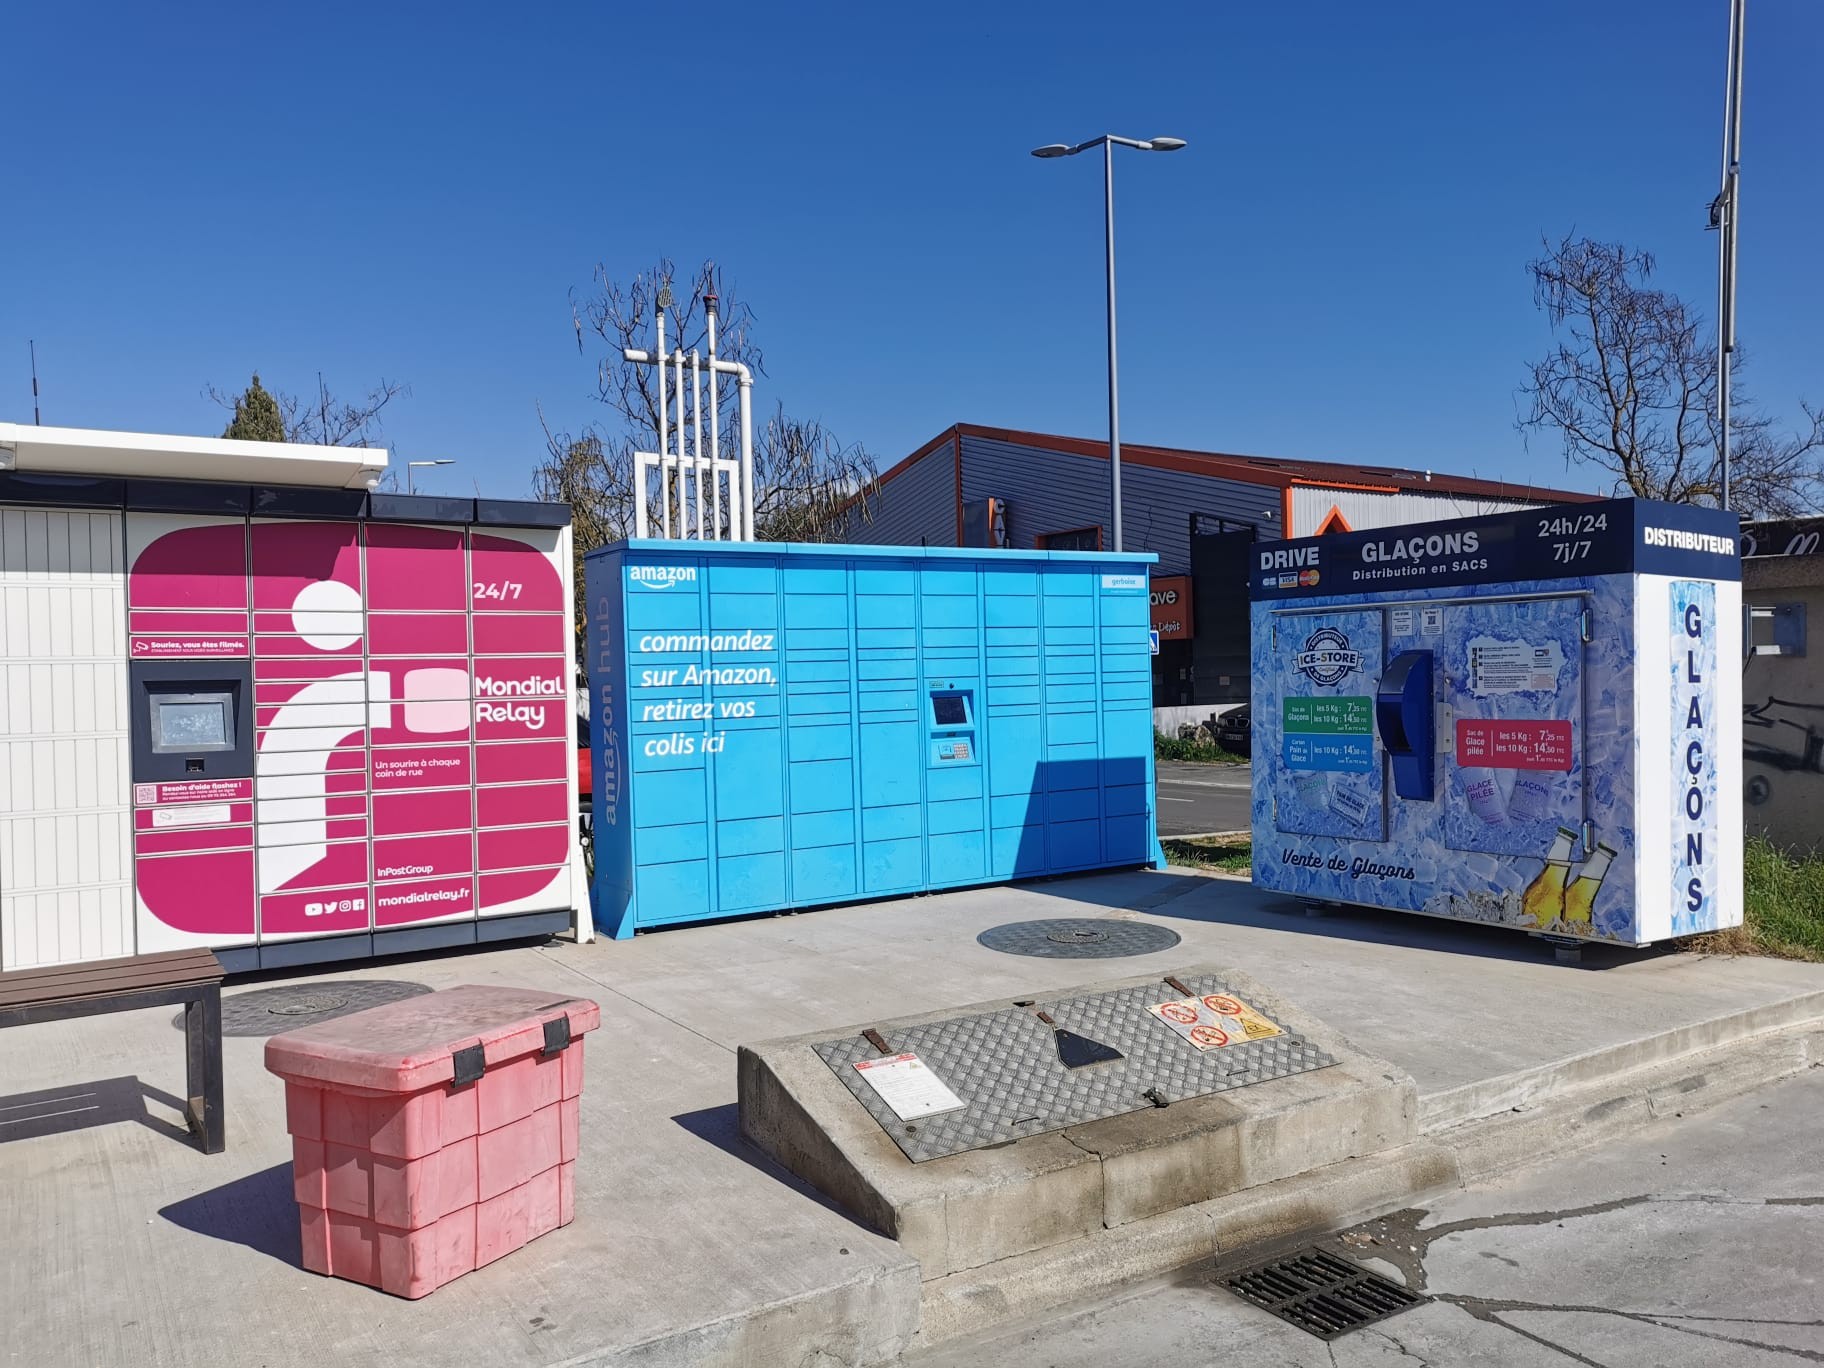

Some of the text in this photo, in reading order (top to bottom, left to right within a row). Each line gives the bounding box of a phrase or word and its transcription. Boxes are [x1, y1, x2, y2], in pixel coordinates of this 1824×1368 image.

[1538, 513, 1608, 537] 24h/24
[1361, 531, 1480, 563] GLAÇONS
[1643, 526, 1735, 555] DISTRIBUTEUR
[1260, 546, 1320, 570] DRIVE
[1552, 541, 1592, 564] 7j/7
[630, 566, 696, 582] amazon
[1352, 558, 1488, 581] Distribution en SACS
[473, 581, 522, 601] 24/7
[151, 641, 181, 649] Souriez,
[595, 597, 612, 673] hub
[639, 630, 774, 652] commandez
[1300, 652, 1356, 666] ICE-STORE
[475, 676, 565, 696] Mondial
[641, 664, 776, 687] sur Amazon,
[475, 702, 546, 730] Relay
[642, 698, 756, 721] retirez vos
[644, 732, 726, 756] colis ici
[1465, 737, 1485, 746] Glace
[1499, 731, 1510, 740] les
[1511, 732, 1516, 740] 5
[1518, 731, 1527, 742] Kg
[601, 684, 619, 827] amazon
[1467, 746, 1484, 756] pilée
[1496, 743, 1507, 752] les
[1508, 744, 1517, 752] 10
[1518, 744, 1528, 753] Kg
[1684, 603, 1704, 912] GLAÇONS
[375, 758, 460, 769] Un sourire à chaque
[375, 769, 395, 778] coin
[395, 768, 407, 777] de
[1466, 780, 1494, 792] GLACE
[1282, 848, 1415, 881] Vente de Glaçons
[378, 887, 470, 907] mondialrelay.fr
